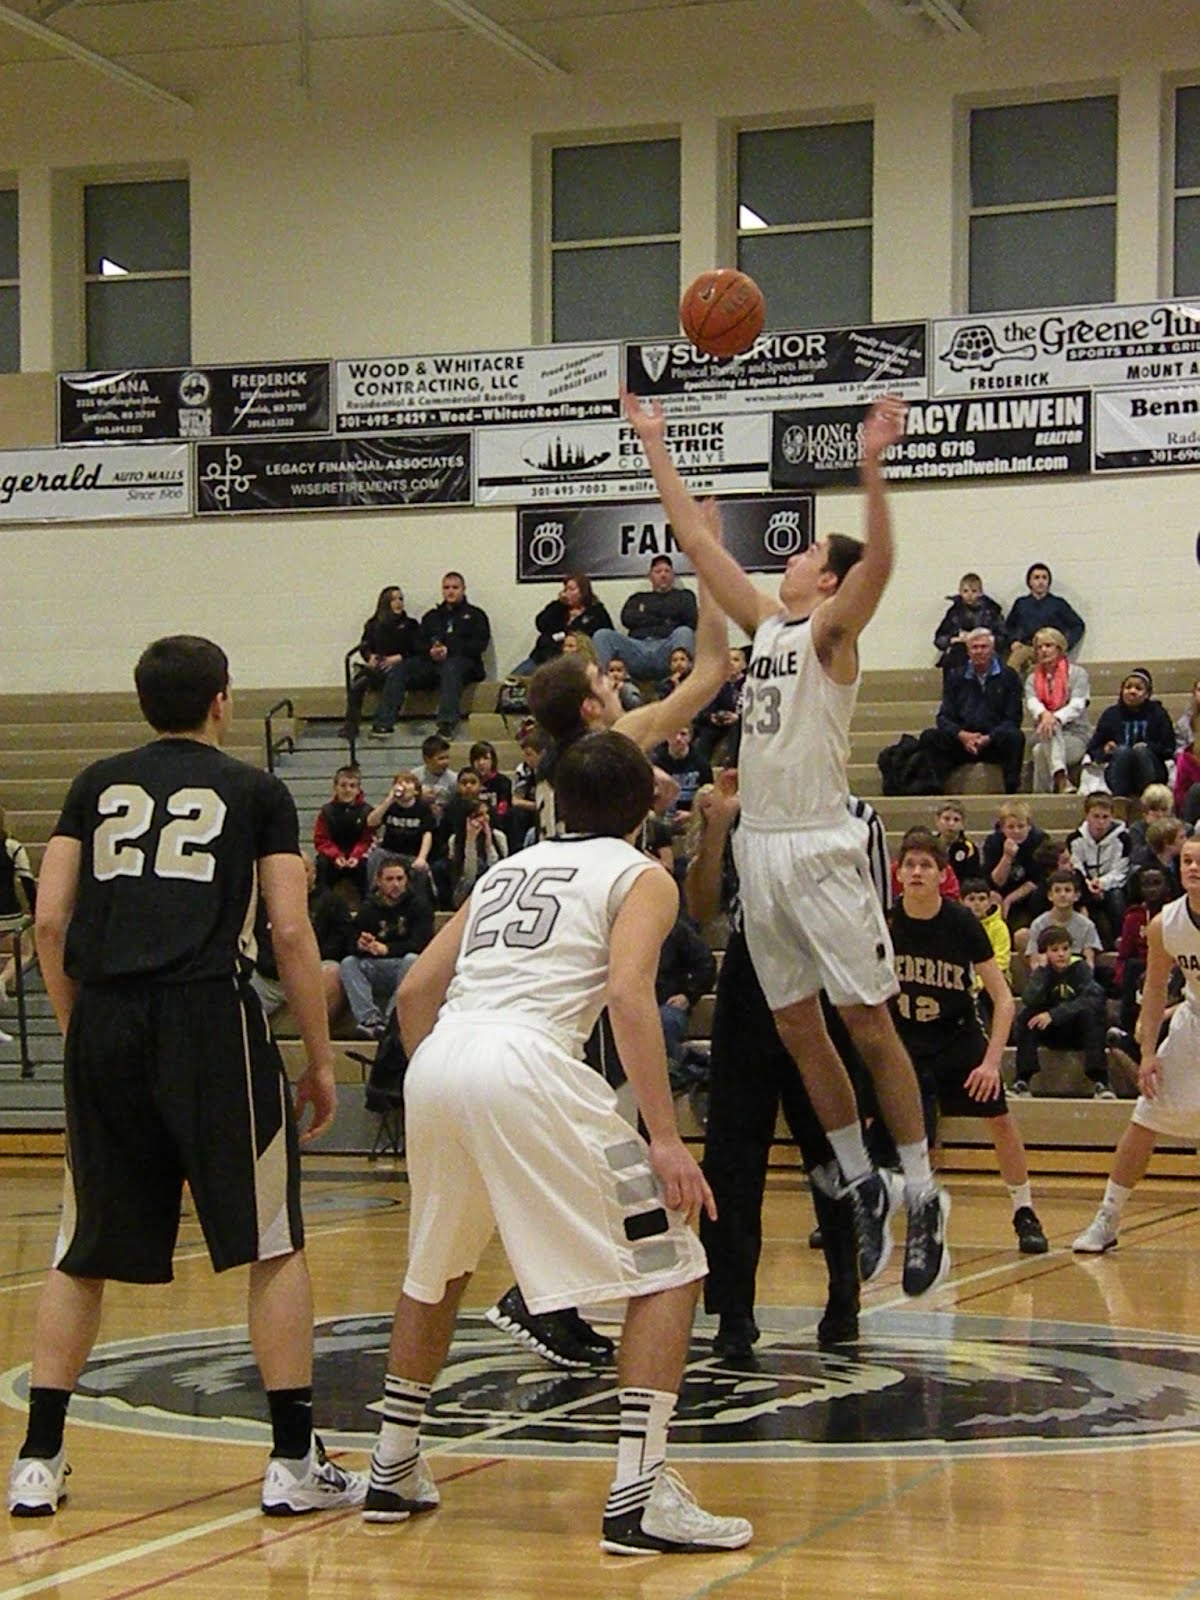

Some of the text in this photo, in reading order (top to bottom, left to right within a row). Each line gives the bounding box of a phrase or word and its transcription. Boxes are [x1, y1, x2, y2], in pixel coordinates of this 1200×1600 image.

[1003, 322, 1036, 341] the
[1040, 317, 1149, 355] Greene
[672, 334, 826, 364] SURIOR
[1068, 347, 1122, 360] SPORTS
[1125, 344, 1154, 357] BAR
[348, 355, 525, 379] WOOD & WHITACRE
[767, 358, 796, 374] Sports
[798, 358, 828, 371] Rehab
[1127, 362, 1183, 379] MOUNT
[232, 371, 308, 388] FREDERICK
[354, 374, 519, 397] CONTRACTING, LLC
[970, 372, 1050, 390] FREDERICK
[484, 392, 526, 403] Roofing
[966, 396, 1084, 426] ALLWEIN
[619, 421, 724, 441] FRERICK
[807, 423, 851, 441] LONG
[1035, 430, 1084, 446] REALTOR
[941, 440, 975, 458] 6716
[265, 456, 464, 476] LEGACY FINANCIAL ASSOCIATES
[112, 471, 143, 482] AUTO
[146, 470, 184, 481] MALLS
[127, 489, 154, 501] Since
[291, 478, 439, 495] WISERETIREMENTS.COM
[743, 686, 781, 735] 23
[93, 783, 227, 882] 22
[465, 867, 578, 957] 25
[898, 993, 940, 1022] 12
